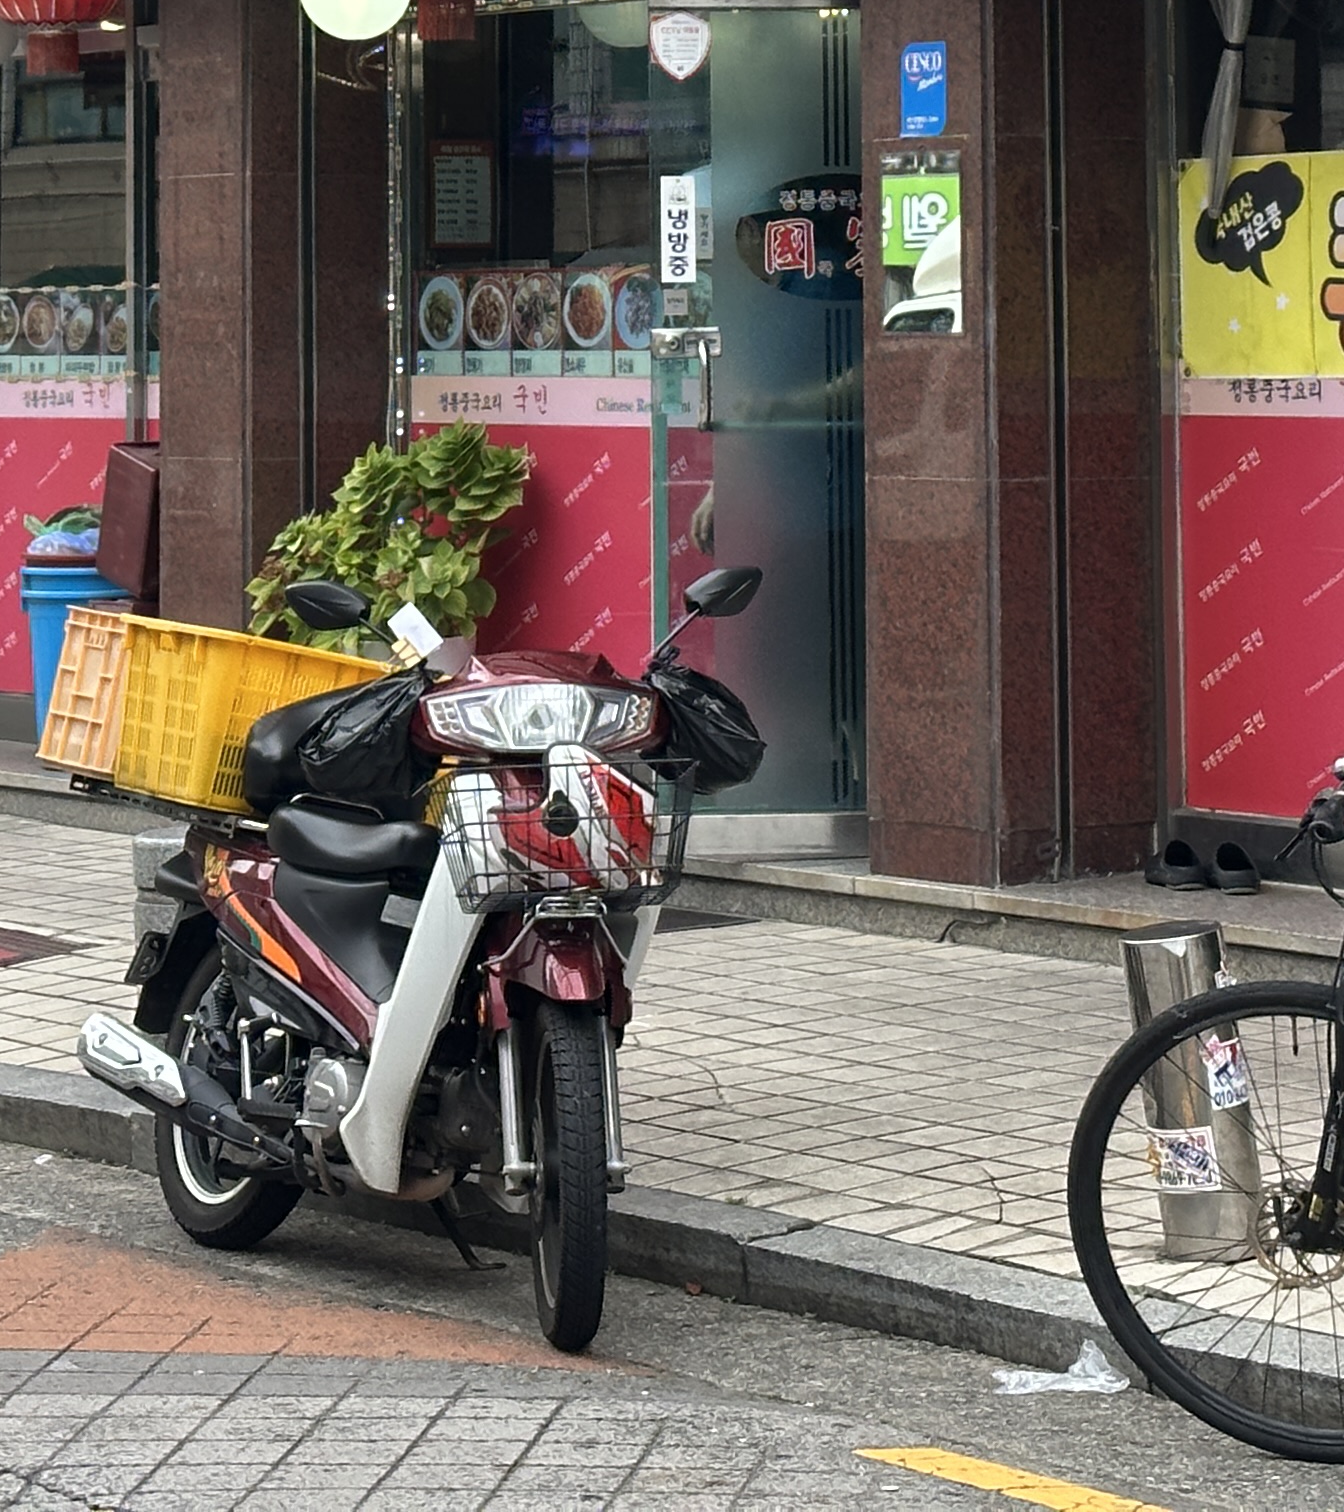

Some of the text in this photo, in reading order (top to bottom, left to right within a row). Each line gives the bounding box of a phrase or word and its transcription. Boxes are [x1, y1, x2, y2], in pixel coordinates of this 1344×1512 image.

[779, 189, 862, 211] 정통중국
[667, 208, 689, 277] 냉방중
[1237, 200, 1282, 253] 검은콩
[513, 384, 549, 416] 국빈
